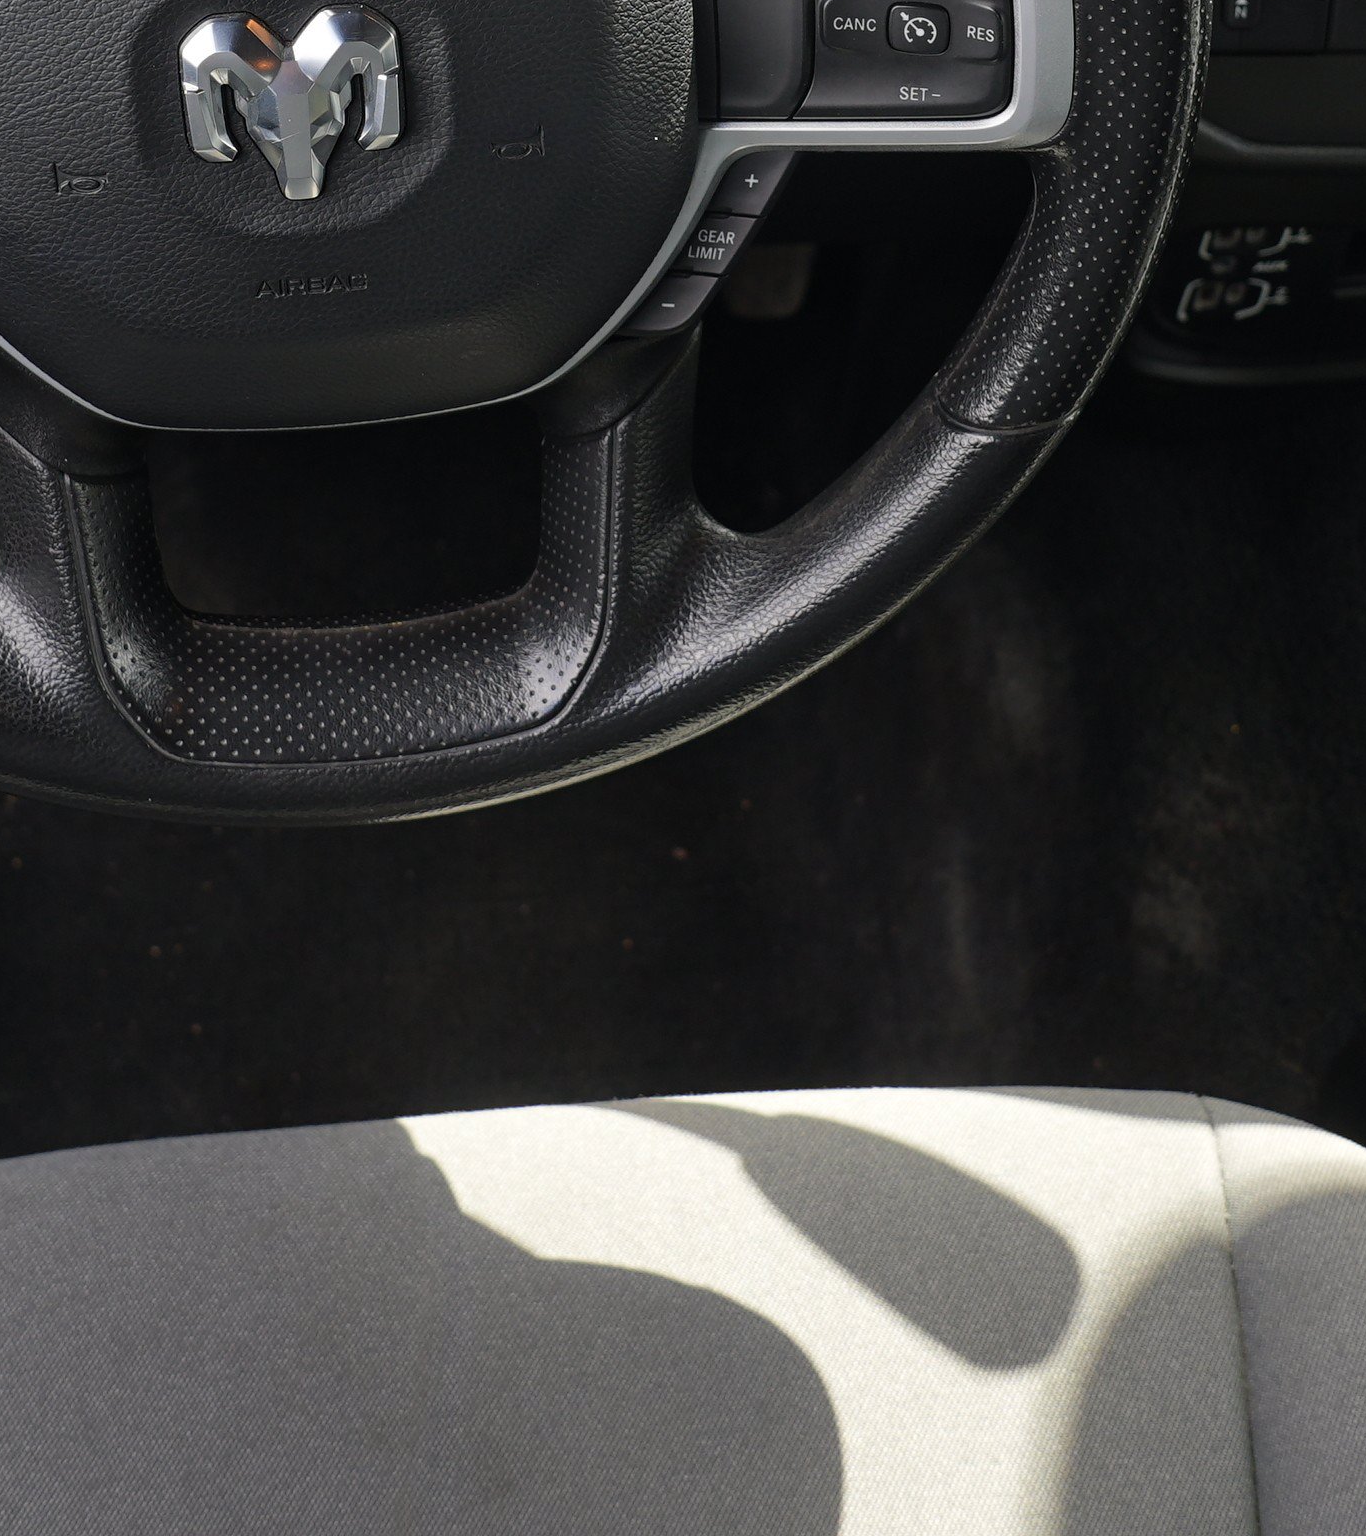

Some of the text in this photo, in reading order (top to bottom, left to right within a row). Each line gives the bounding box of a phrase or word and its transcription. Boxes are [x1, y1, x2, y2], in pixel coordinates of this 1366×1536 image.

[1235, 5, 1249, 20] N
[833, 16, 877, 32] CANC
[966, 25, 995, 43] RES
[697, 229, 735, 245] GEAR
[688, 244, 726, 261] LIMIT
[254, 272, 369, 300] AIRBAG
